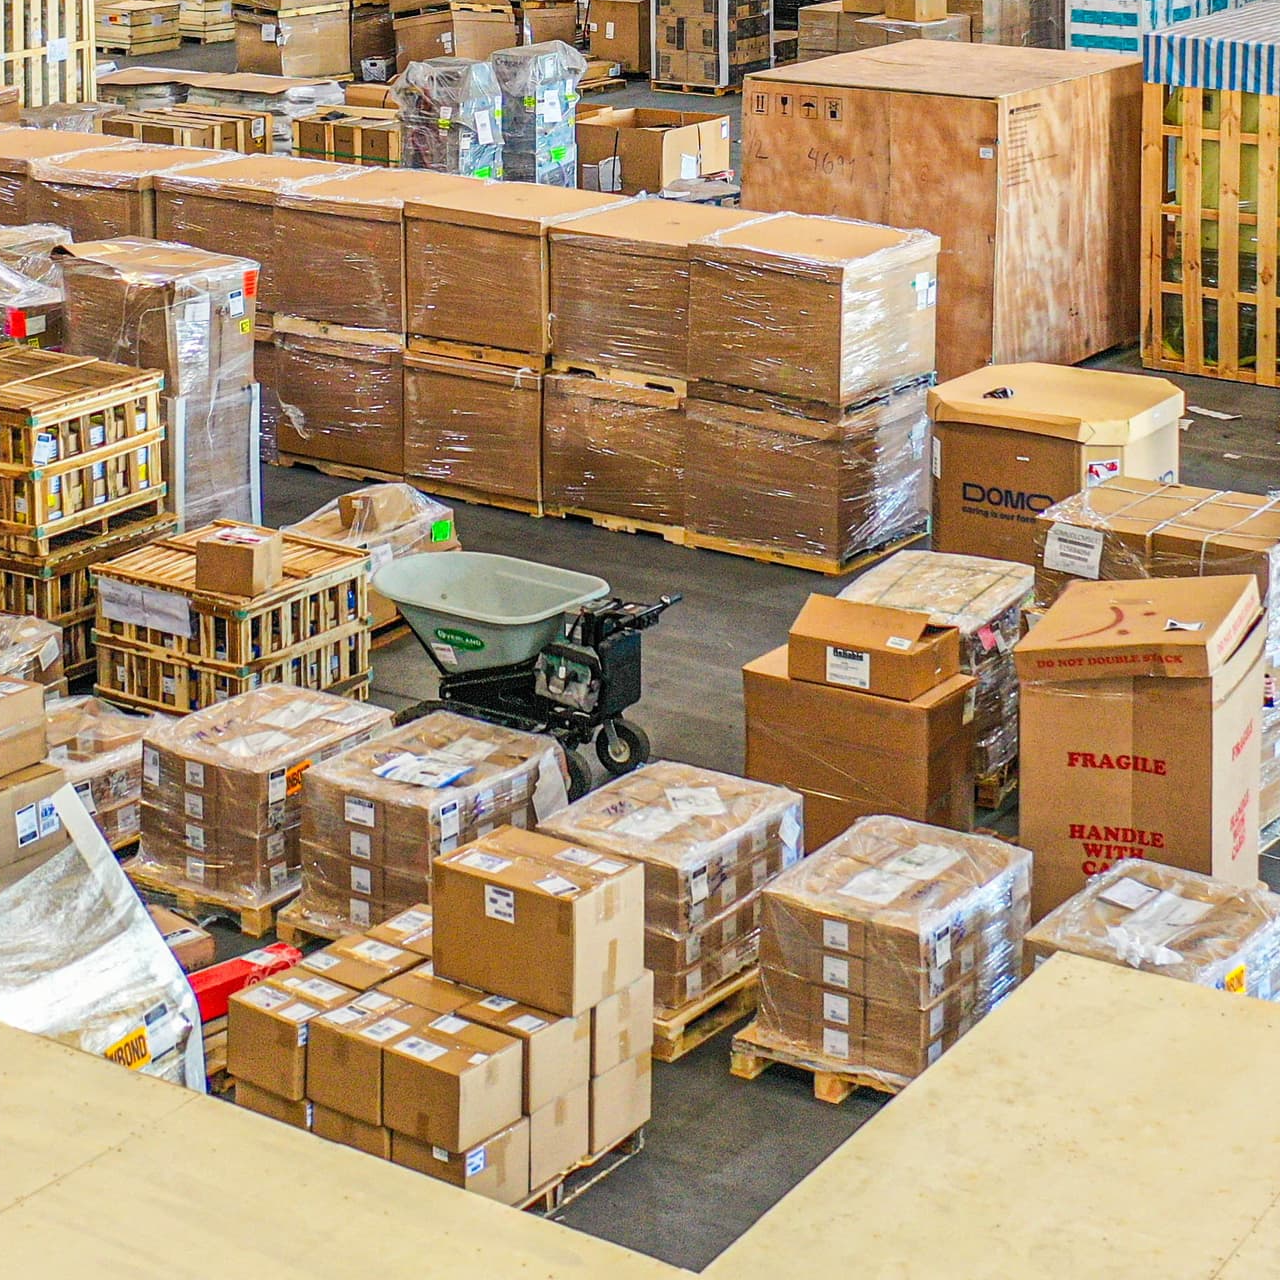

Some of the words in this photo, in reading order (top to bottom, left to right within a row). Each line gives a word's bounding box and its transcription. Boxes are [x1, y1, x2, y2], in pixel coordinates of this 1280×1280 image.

[962, 482, 1056, 514] DOMO
[1036, 659, 1055, 669] DO
[1058, 657, 1084, 667] NOT
[1088, 655, 1140, 666] DOUBLE
[1142, 653, 1184, 665] STACK
[1067, 751, 1167, 776] FRAGILE
[1068, 824, 1165, 848] HANDLE
[1082, 842, 1145, 861] WITH
[1081, 860, 1111, 876] CA
